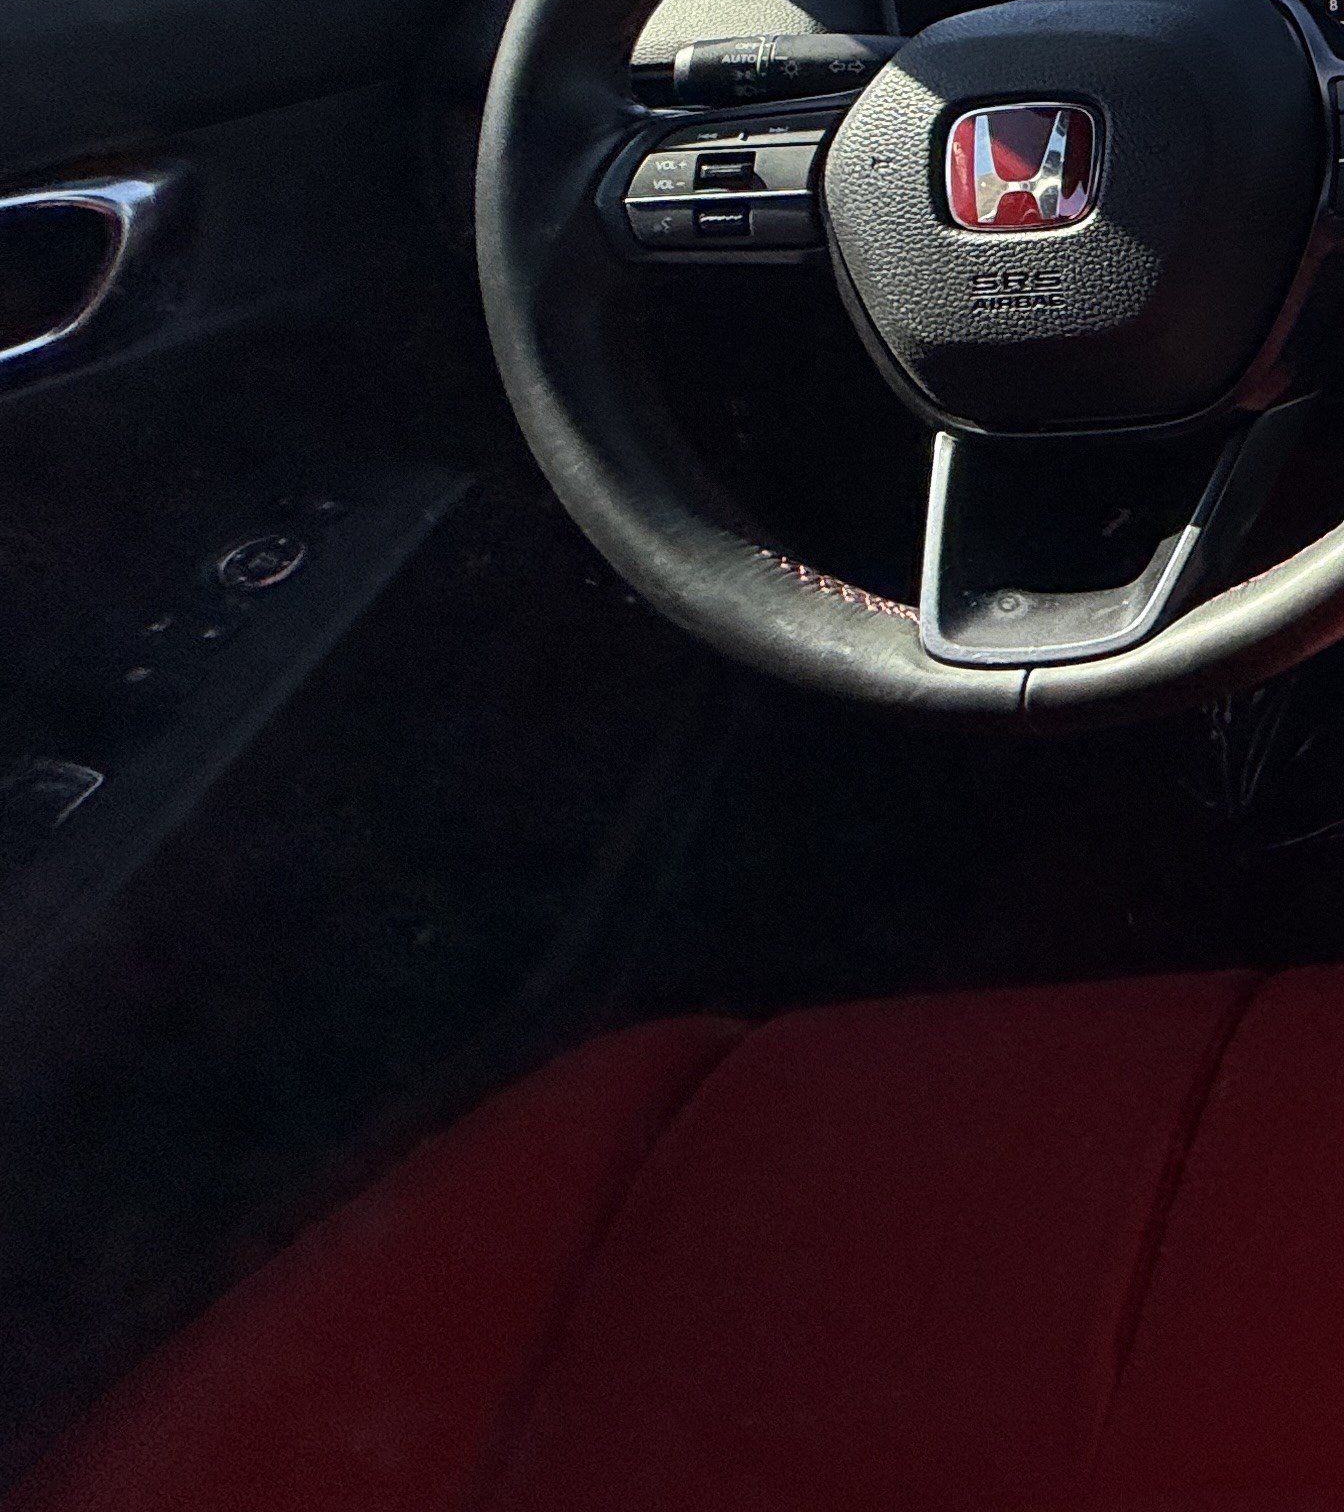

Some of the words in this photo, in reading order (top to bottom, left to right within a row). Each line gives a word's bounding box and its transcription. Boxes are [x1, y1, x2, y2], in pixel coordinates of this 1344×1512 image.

[722, 53, 757, 64] AUTO
[656, 160, 678, 171] VOL
[653, 179, 675, 190] VOL
[970, 270, 1062, 294] SRS
